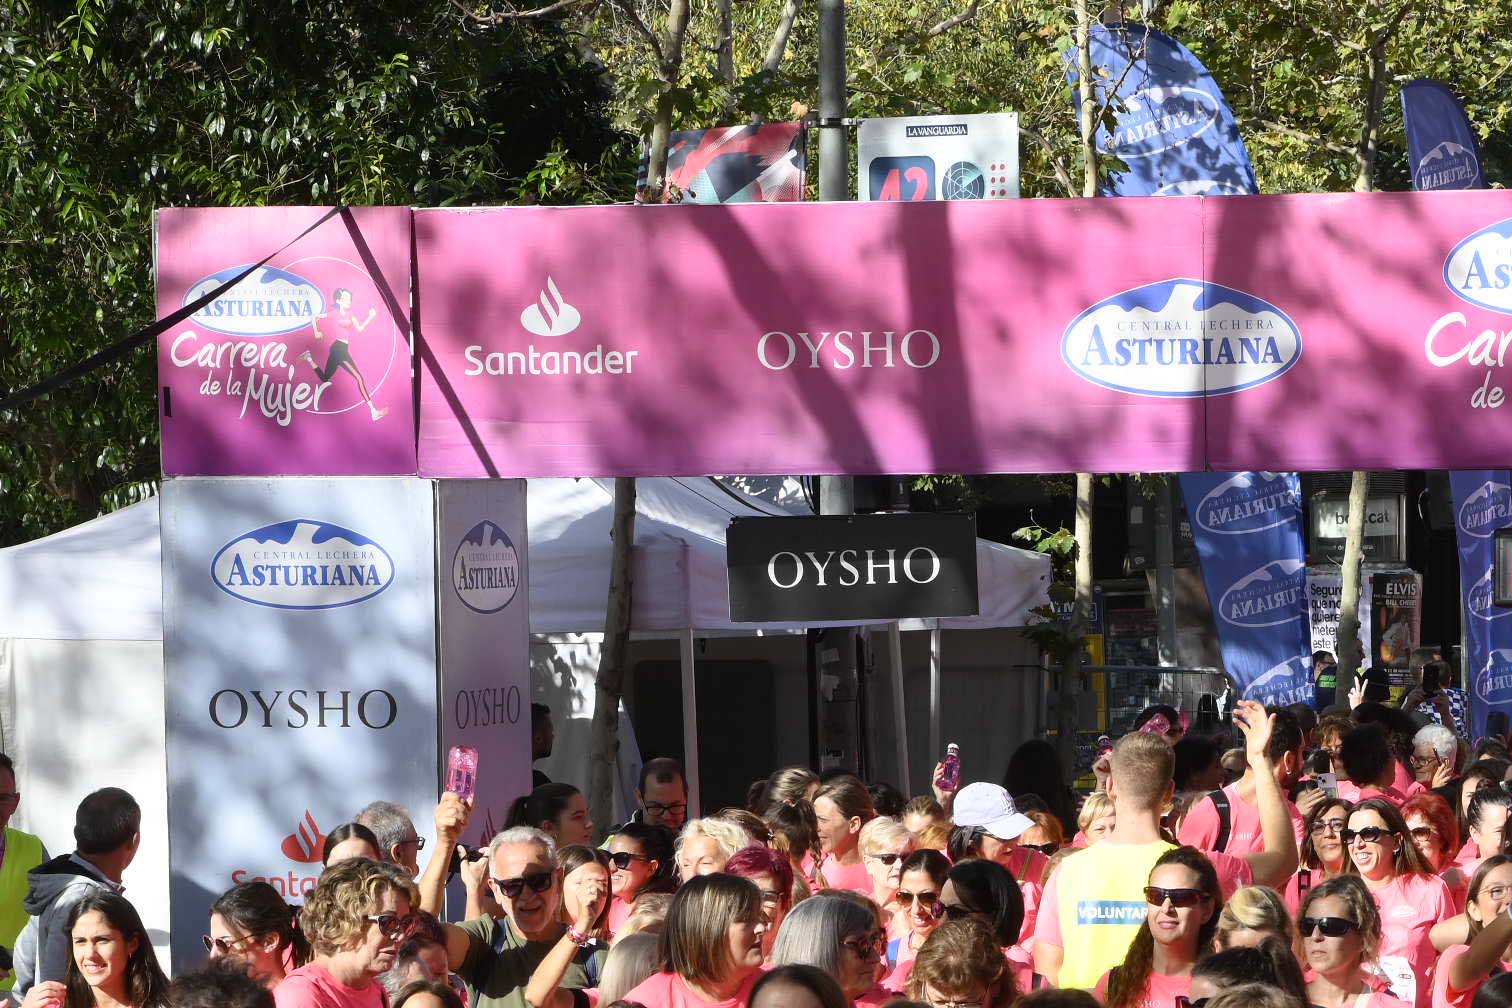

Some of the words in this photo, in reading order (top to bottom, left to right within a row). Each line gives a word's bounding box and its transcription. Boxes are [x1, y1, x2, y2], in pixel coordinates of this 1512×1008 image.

[194, 290, 314, 317] ASTURIANA
[1116, 319, 1191, 332] CENTRAL
[1200, 318, 1275, 331] LECHERA
[170, 330, 288, 368] Carrera
[464, 344, 639, 376] Santander
[757, 328, 940, 372] OYSHO
[1081, 322, 1282, 368] ASTURIANA
[200, 370, 221, 396] de
[226, 369, 242, 396] la
[240, 363, 333, 427] Mujer
[1471, 370, 1505, 410] de
[227, 552, 382, 588] ASTURIANA
[253, 550, 310, 561] CENTRAL
[316, 549, 376, 561] LECHERA
[767, 546, 941, 590] OYSHO
[458, 561, 517, 592] ASTURIANA
[1386, 583, 1417, 594] ELVIS
[208, 688, 398, 730] OYSHO
[455, 684, 521, 730] OYSHO
